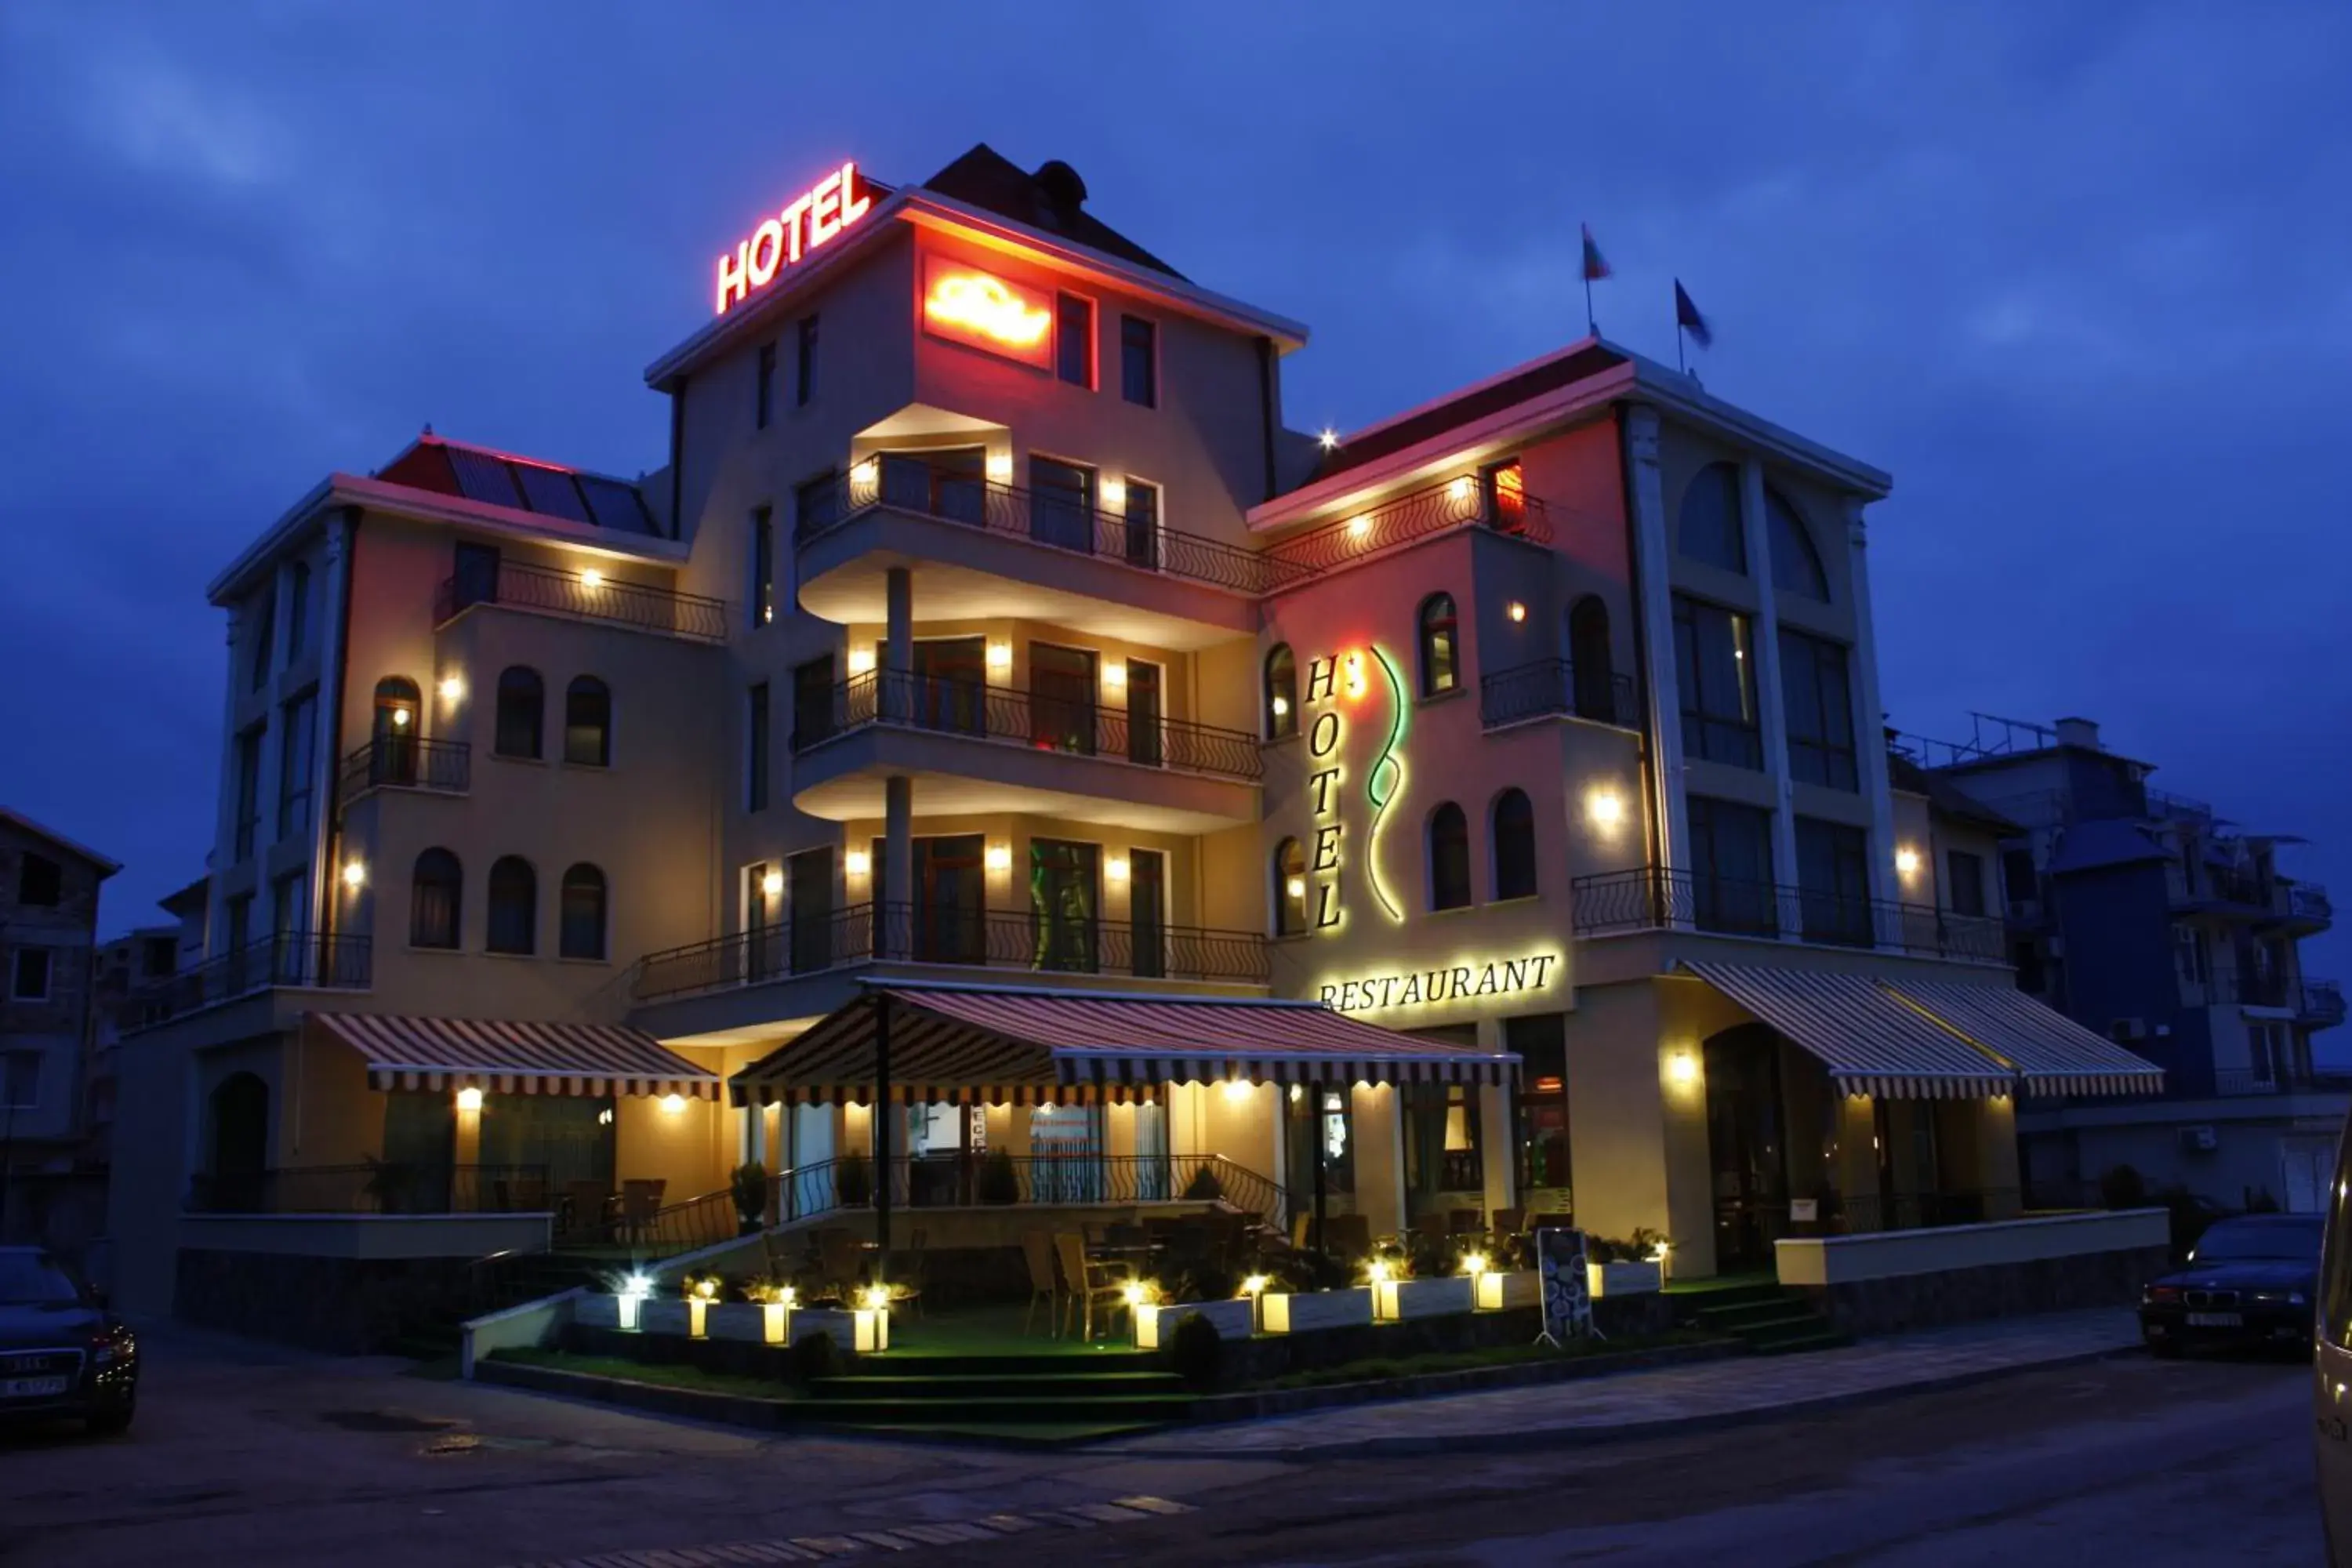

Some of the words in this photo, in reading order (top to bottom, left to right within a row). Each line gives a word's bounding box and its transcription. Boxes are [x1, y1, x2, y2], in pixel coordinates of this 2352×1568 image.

[717, 162, 870, 314] HOTEL
[1305, 654, 1340, 929] HOTEL
[1320, 955, 1555, 1011] RESTAURANT
